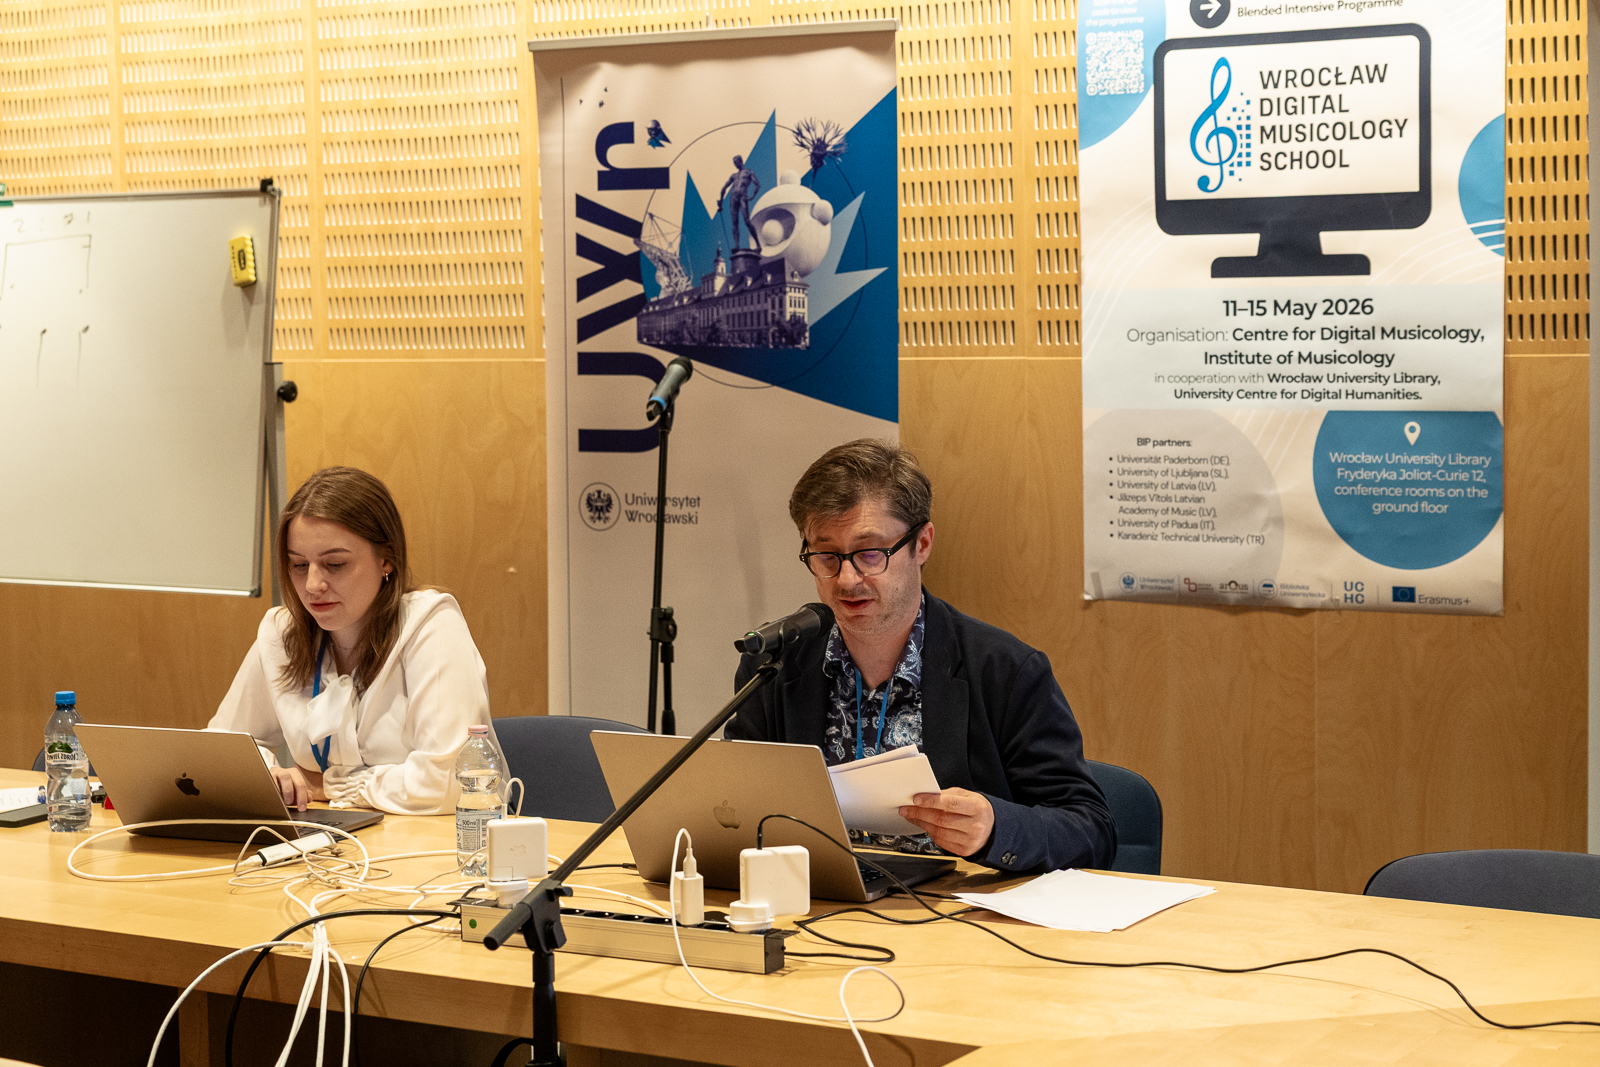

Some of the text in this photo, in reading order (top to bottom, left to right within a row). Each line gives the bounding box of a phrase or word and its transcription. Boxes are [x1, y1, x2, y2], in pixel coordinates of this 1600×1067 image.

[1237, 0, 1403, 17] Blended Intensive Programme
[1259, 63, 1389, 90] WROCŁAW
[1259, 94, 1350, 117] DIGITAL
[1259, 118, 1409, 145] MUSICOLOGY
[1259, 149, 1350, 172] SCHOOL
[1273, 299, 1318, 320] May
[1322, 298, 1374, 316] 2026
[1126, 324, 1485, 345] Organisation: Centre for Digital Musicology,
[1203, 350, 1395, 368] Institute of Musicology
[1154, 372, 1441, 387] in cooperation with Wrocław University Library,
[1173, 388, 1422, 403] University Centre for Digital Humanities.
[1136, 438, 1192, 449] BIP partners:
[1163, 455, 1208, 465] Paderborn
[1329, 452, 1491, 468] Wrocław University Library
[1117, 467, 1158, 478] University
[1160, 468, 1170, 477] of
[1171, 468, 1209, 479] Ljubljana
[1337, 468, 1487, 483] Fryderyka Joliot-Curie 12,
[1117, 480, 1158, 491] University
[1160, 481, 1170, 490] of
[1171, 481, 1197, 491] Latvia
[1334, 484, 1489, 498] conference rooms on the
[625, 492, 701, 510] Uniwrsytet
[1174, 494, 1206, 504] Latvian
[1118, 506, 1158, 516] Academy
[1160, 506, 1170, 516] of
[1171, 507, 1197, 517] Music
[1372, 501, 1449, 515] ground floor
[625, 510, 699, 525] Wrocawski
[1117, 519, 1158, 529] University
[1160, 519, 1170, 529] of
[1171, 519, 1199, 529] Padua
[1118, 531, 1265, 546] Karadeniz Technical University (TR)
[1344, 581, 1365, 593] UC
[1344, 593, 1365, 604] HC
[1418, 594, 1471, 606] Erasmus+
